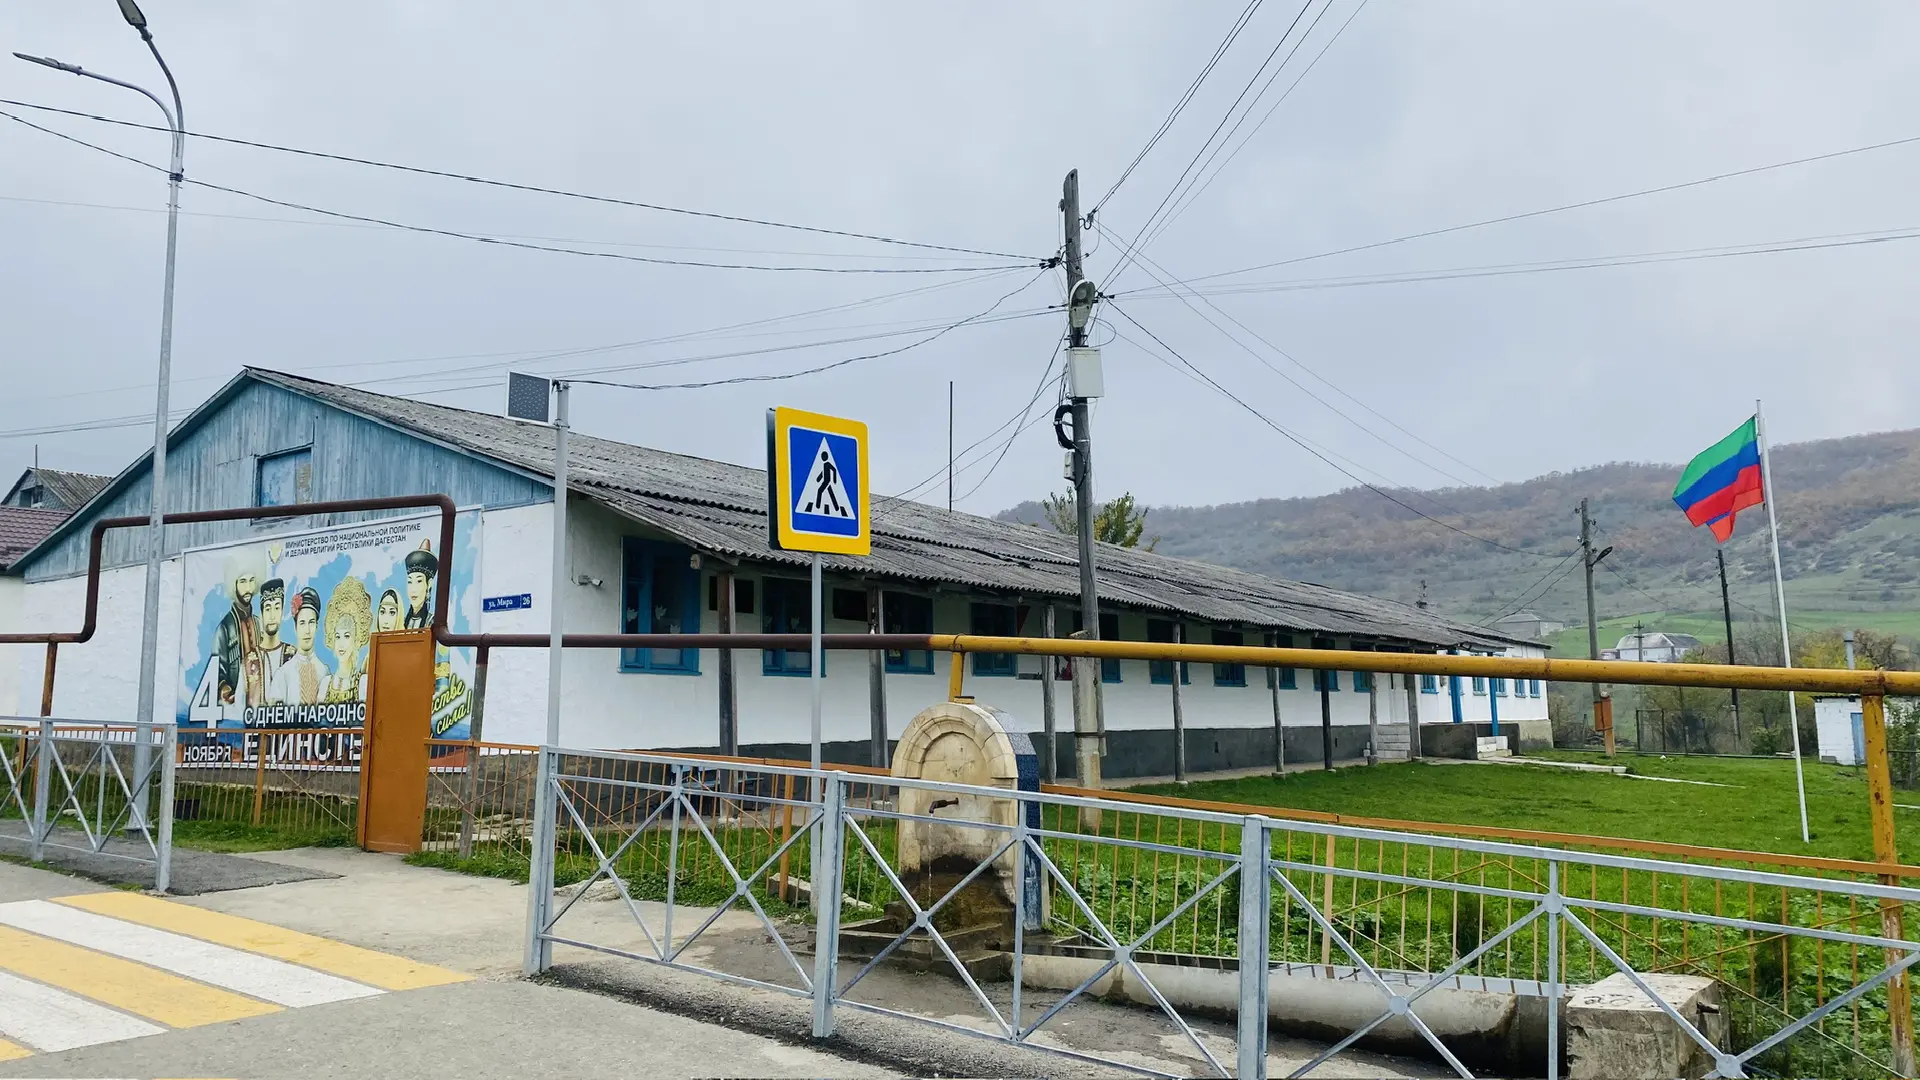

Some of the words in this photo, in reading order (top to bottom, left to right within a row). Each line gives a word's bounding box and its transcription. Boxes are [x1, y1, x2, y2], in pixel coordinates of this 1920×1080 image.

[285, 536, 329, 549] МИНИСТЕРСТВО
[329, 534, 339, 543] ПО
[339, 526, 388, 541] НАЦИОНАЛЬНОЙ
[389, 523, 421, 535] ПОЛИТИКЕ
[290, 547, 309, 558] ДЕЛАМ
[336, 539, 374, 551] РЕСПУБЛИКИ
[374, 535, 407, 547] ДАГЕСТАН
[497, 598, 513, 608] Мира
[522, 596, 531, 605] 26
[189, 655, 224, 737] 4
[244, 708, 254, 725] С
[256, 702, 295, 728] ДНЁМ
[183, 745, 232, 762] НОЯБРЯ
